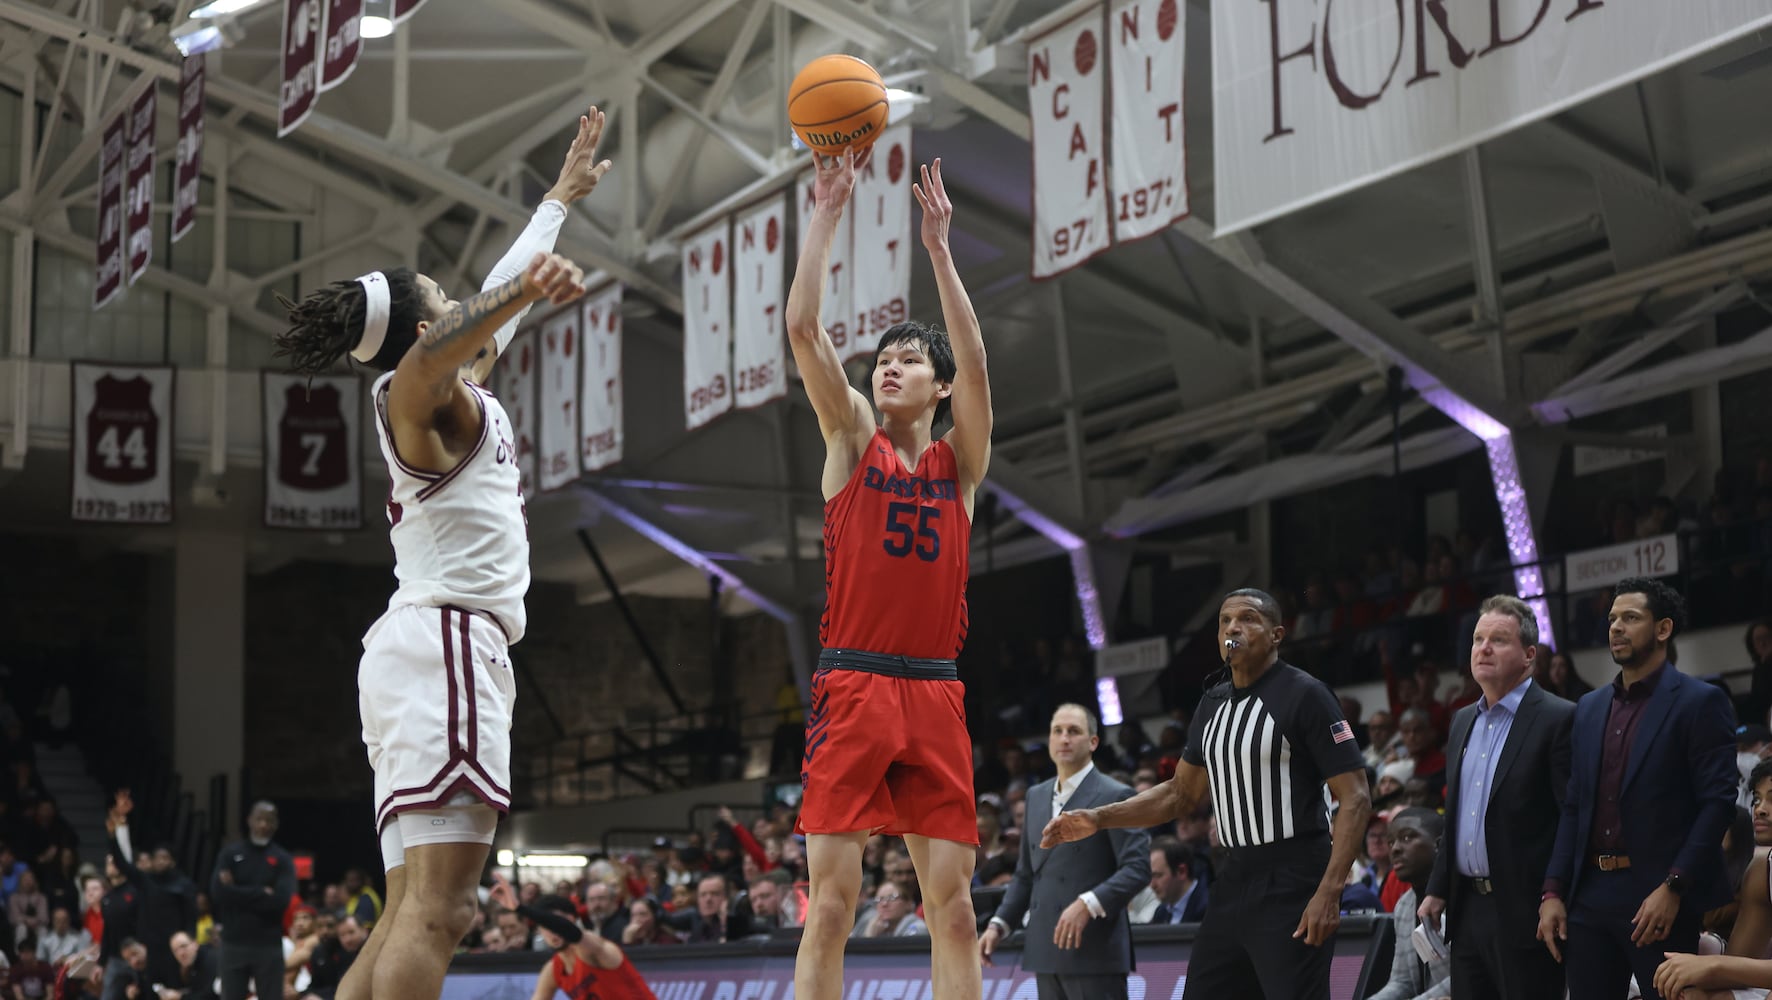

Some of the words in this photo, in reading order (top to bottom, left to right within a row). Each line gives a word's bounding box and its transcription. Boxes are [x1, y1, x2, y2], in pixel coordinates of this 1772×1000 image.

[1262, 0, 1605, 144] FOR
[805, 120, 874, 147] Wilson
[96, 425, 149, 469] 44
[299, 433, 328, 476] 7
[864, 465, 957, 501] DAYTON
[883, 501, 940, 562] 55
[1576, 556, 1628, 581] SECTION
[1634, 540, 1666, 577] 112
